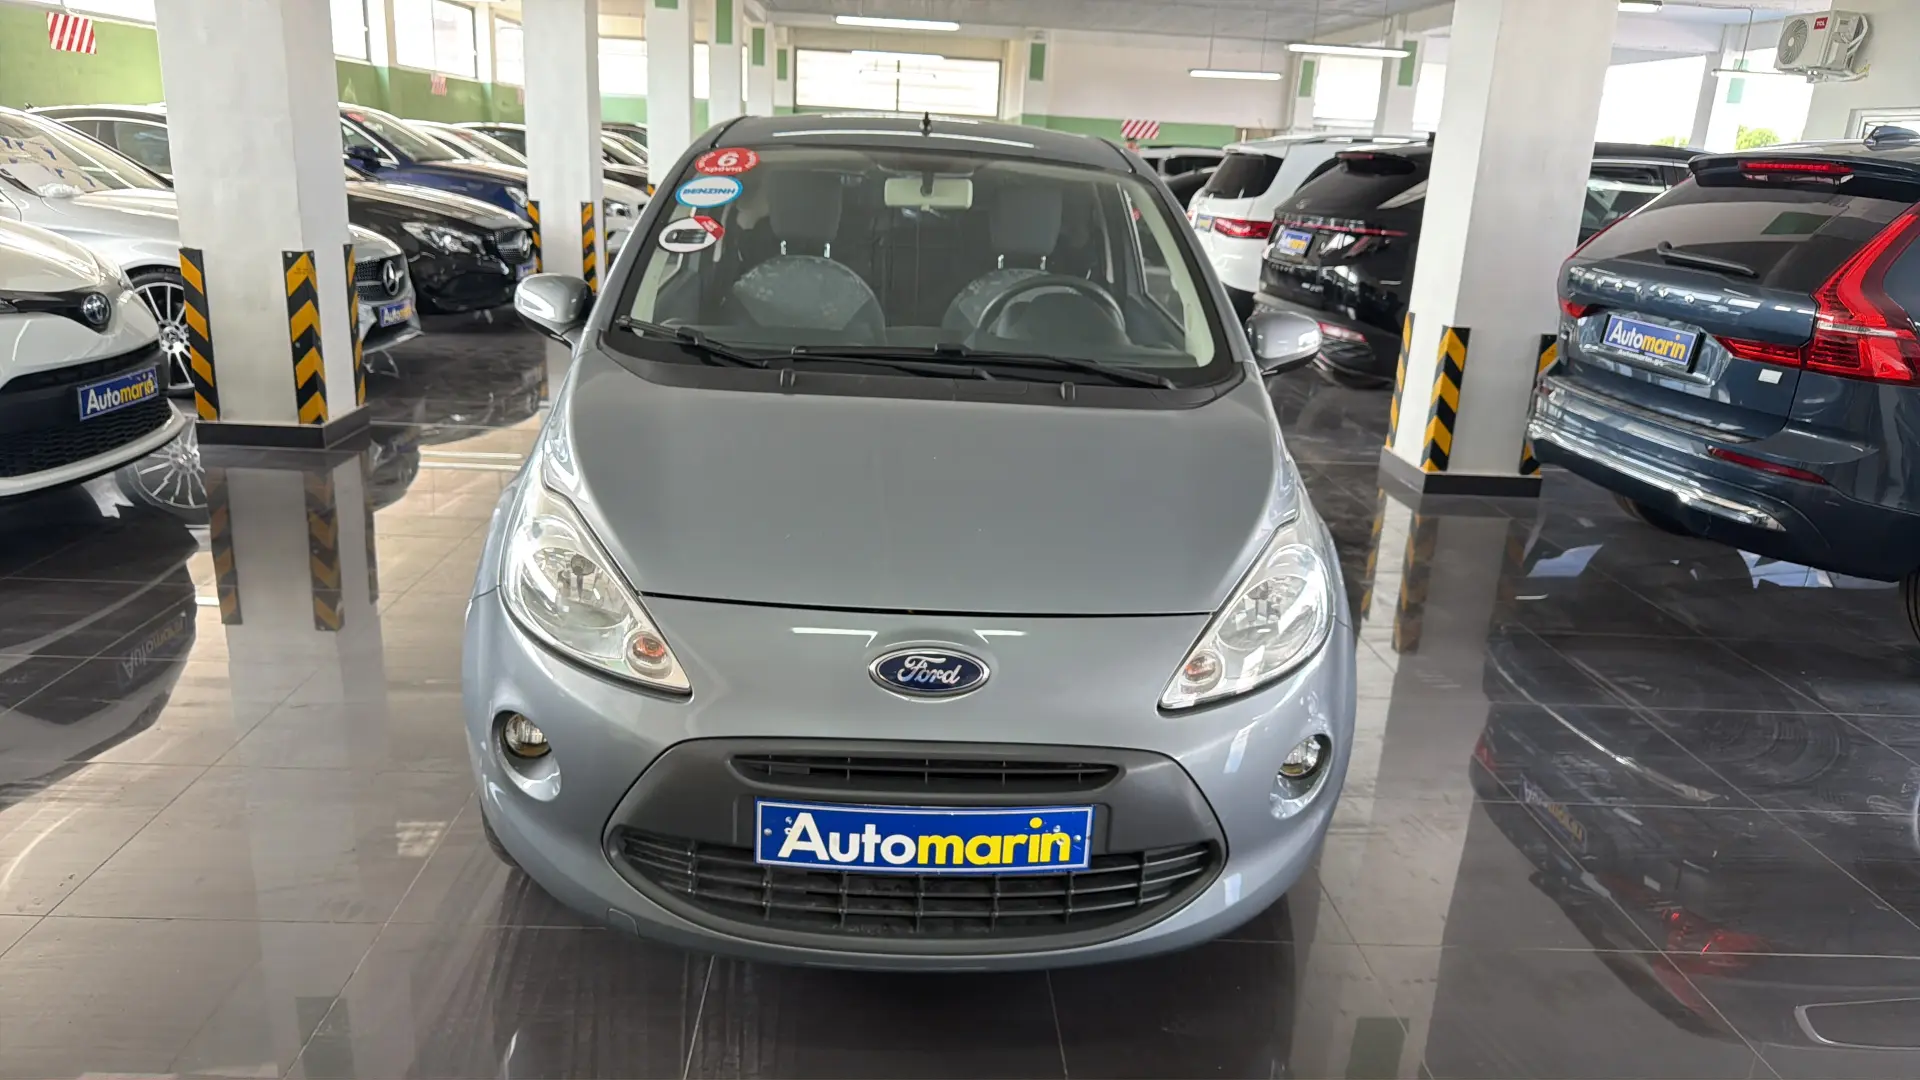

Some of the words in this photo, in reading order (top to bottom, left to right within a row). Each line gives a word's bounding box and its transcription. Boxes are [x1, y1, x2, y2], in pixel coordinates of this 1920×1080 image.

[717, 151, 739, 167] 6
[1608, 320, 1686, 360] Automarin
[87, 373, 155, 415] Automarin
[897, 655, 962, 685] Ford
[777, 812, 1070, 865] Automarin
